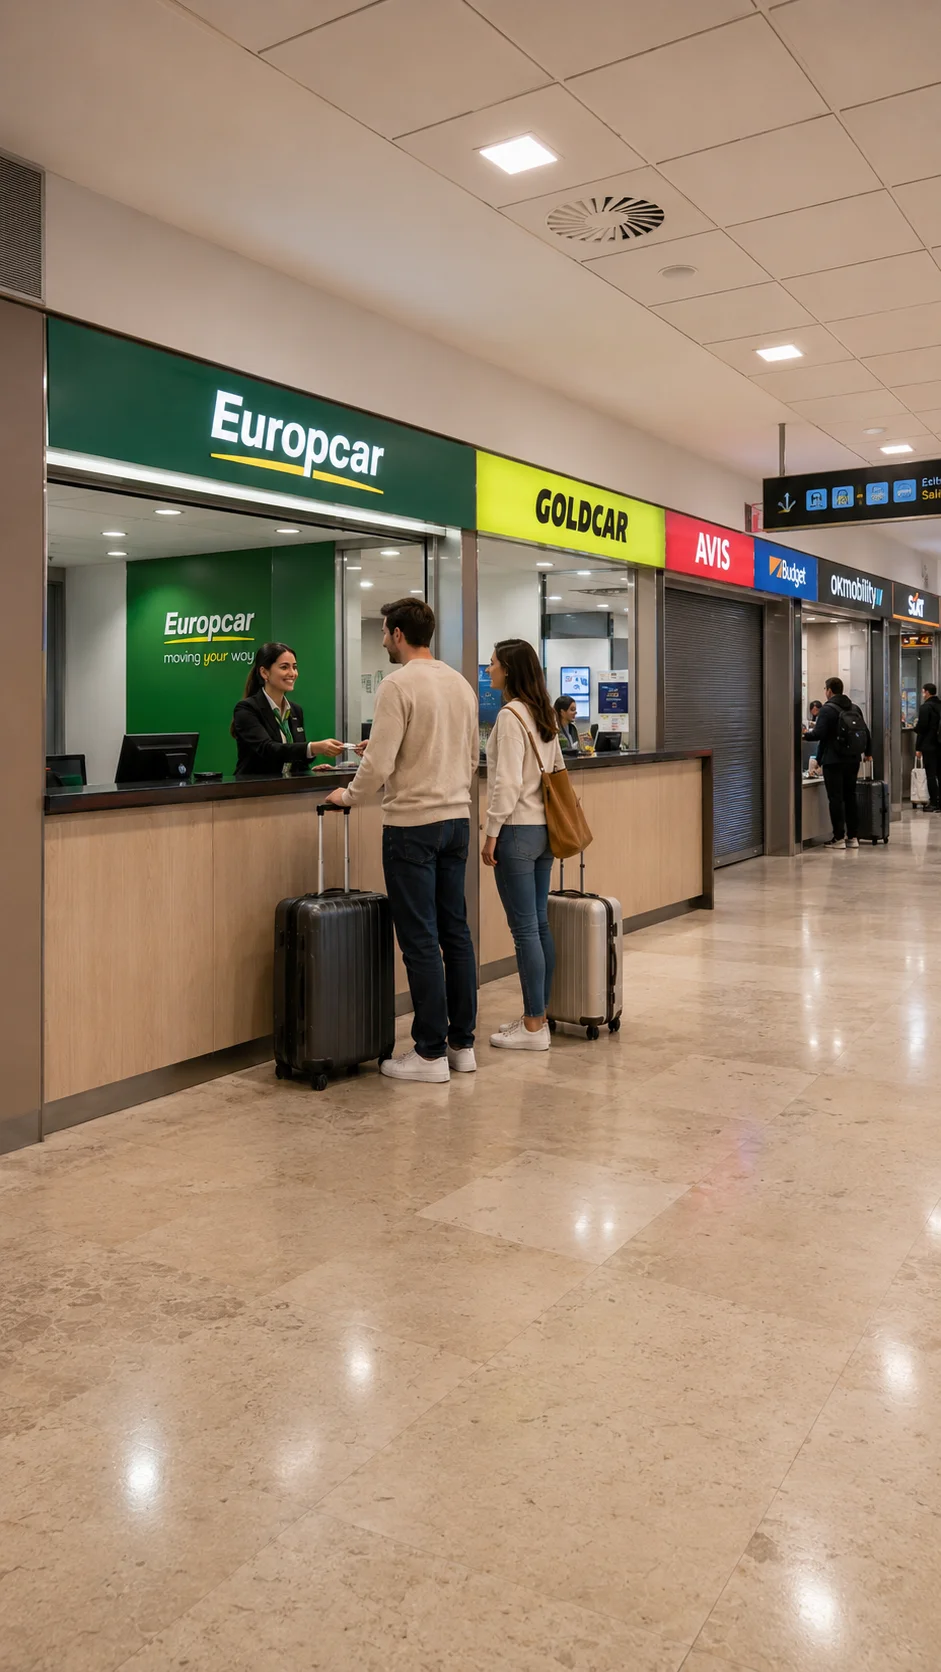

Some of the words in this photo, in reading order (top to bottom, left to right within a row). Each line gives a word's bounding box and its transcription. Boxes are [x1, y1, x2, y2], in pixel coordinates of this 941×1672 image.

[211, 390, 384, 477] Europcar
[536, 488, 628, 542] GOLDCAR
[695, 532, 730, 570] AVIS
[782, 559, 806, 588] Budget
[164, 612, 255, 641] Europcar
[164, 651, 201, 665] moving
[203, 651, 228, 666] your
